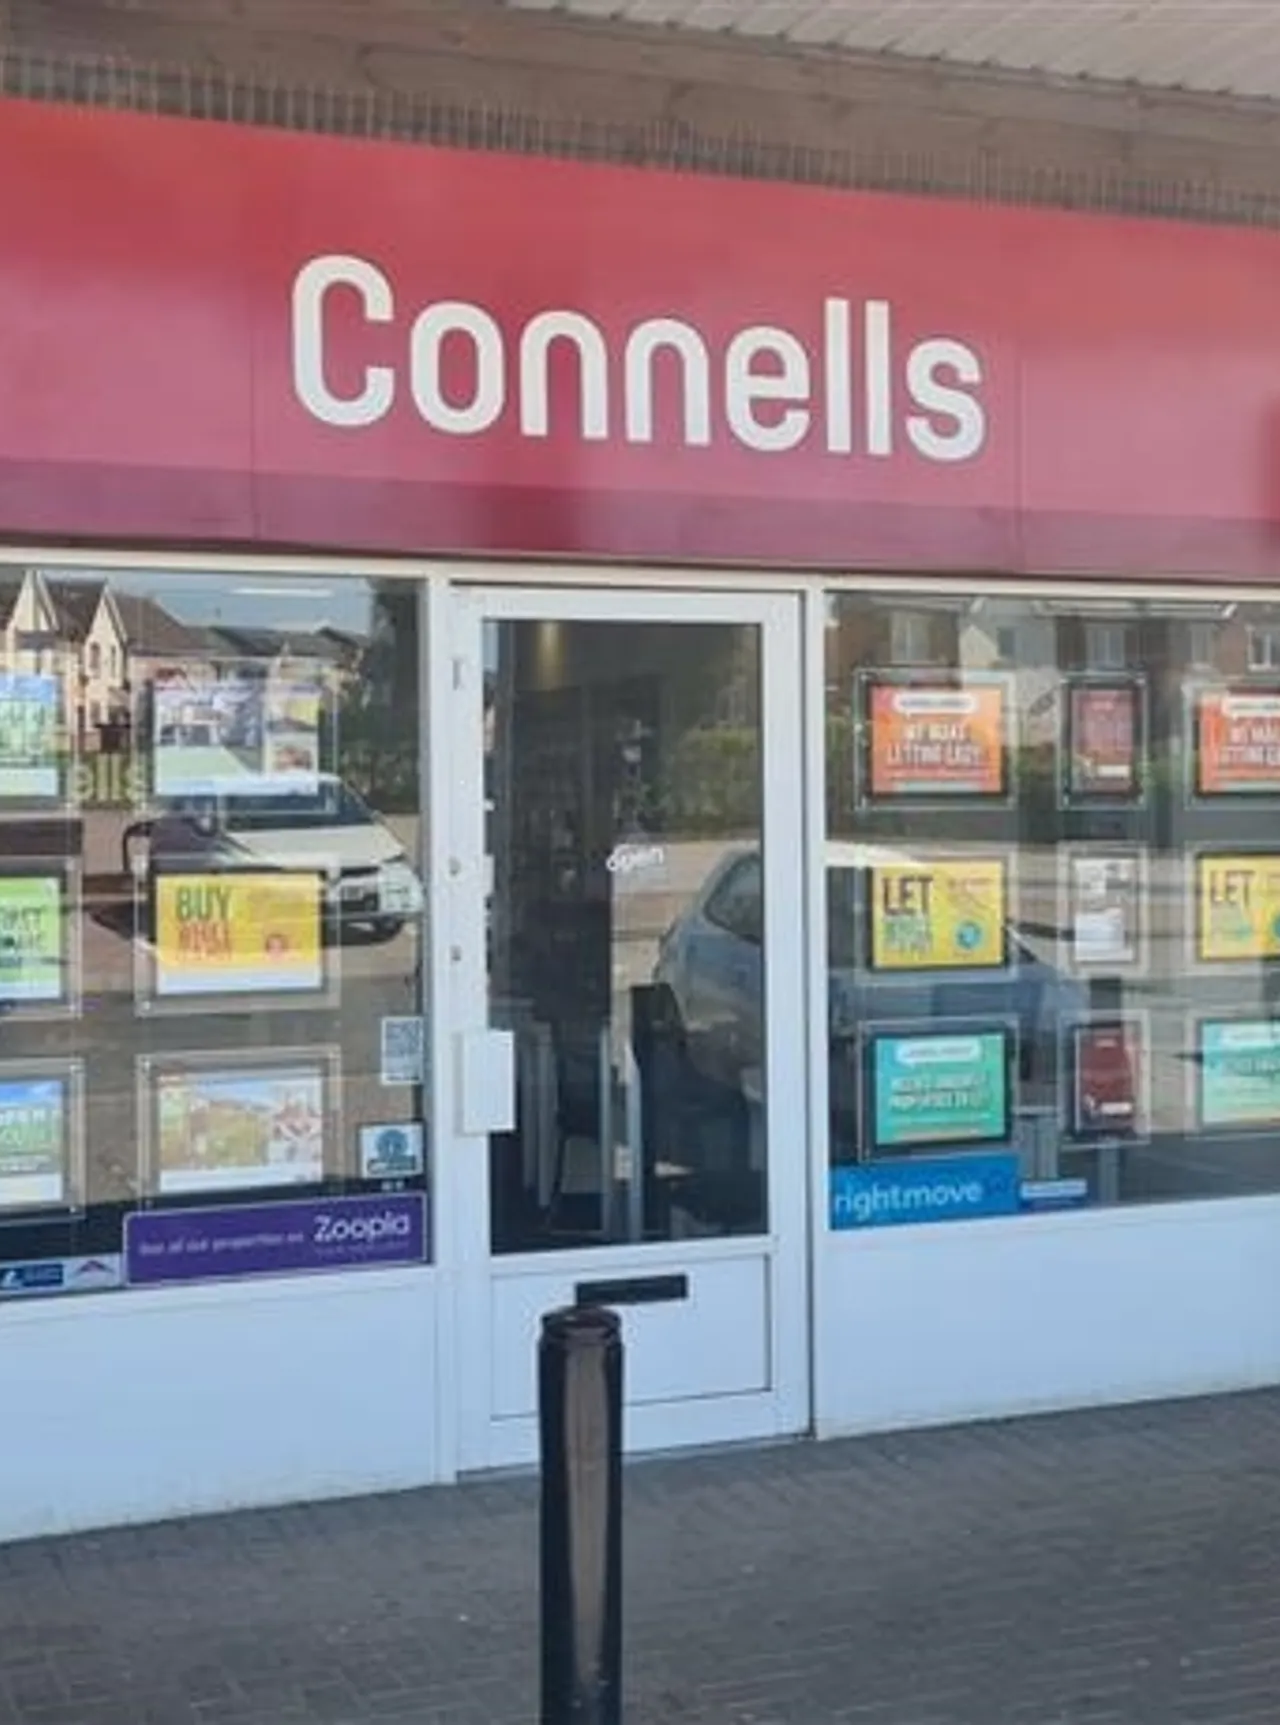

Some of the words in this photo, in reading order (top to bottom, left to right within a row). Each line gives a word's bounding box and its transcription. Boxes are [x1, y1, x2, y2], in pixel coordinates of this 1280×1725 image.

[291, 253, 986, 464] Connells
[176, 884, 231, 922] BUY
[882, 875, 933, 916] LET
[1211, 869, 1255, 906] LET
[834, 1179, 984, 1221] rightmove
[314, 1212, 410, 1243] Zoopla
